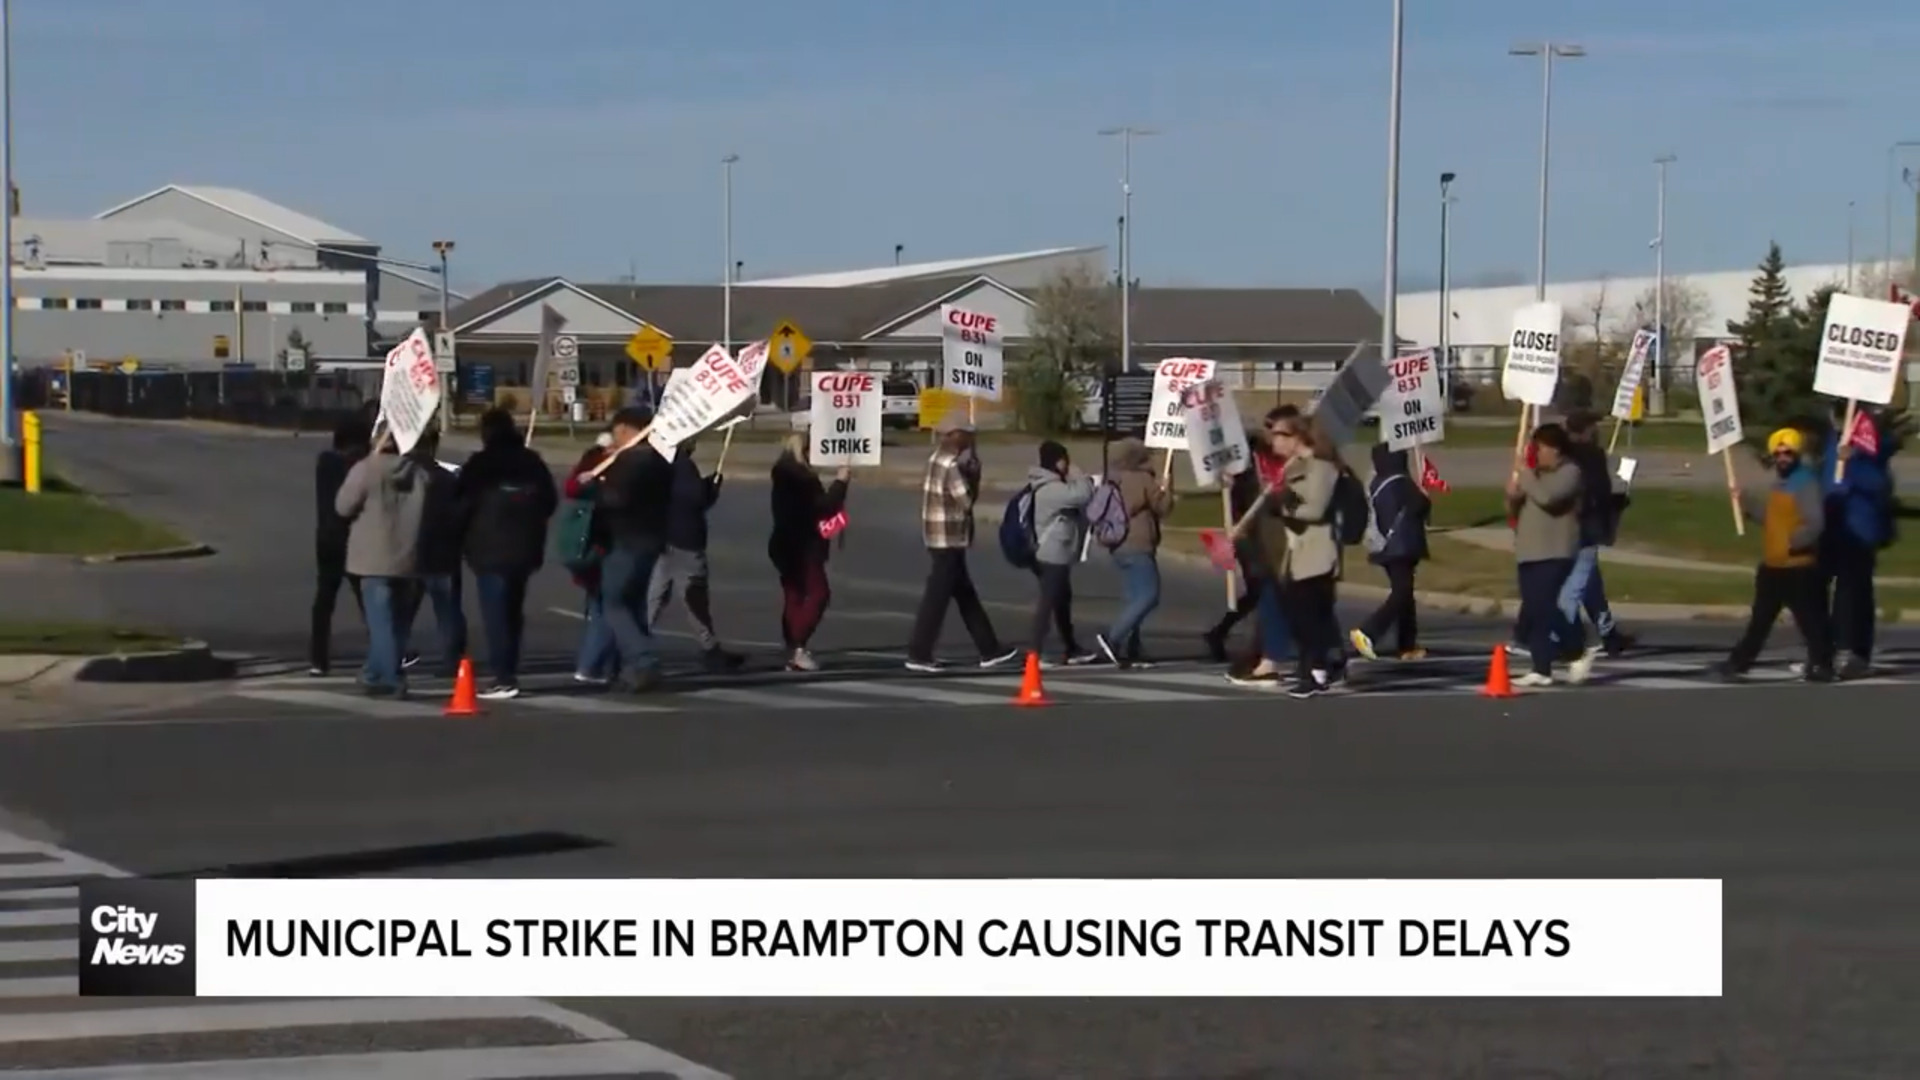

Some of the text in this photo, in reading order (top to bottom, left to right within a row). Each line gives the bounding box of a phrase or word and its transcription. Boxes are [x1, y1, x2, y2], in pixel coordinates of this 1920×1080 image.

[949, 310, 997, 333] CUPE
[961, 329, 986, 344] 831
[1828, 323, 1899, 352] CLOSED
[964, 351, 983, 367] ON
[1388, 356, 1430, 378] UPE
[560, 368, 577, 382] 40
[704, 350, 749, 394] CUPE
[1160, 362, 1208, 379] CUPE
[694, 369, 723, 397] 831
[818, 375, 875, 392] CUPE
[951, 368, 996, 391] STRIKE
[1398, 377, 1422, 394] 831
[832, 394, 861, 409] 831
[1403, 400, 1421, 416] ON
[836, 417, 856, 433] ON
[1151, 421, 1188, 438] STRIK
[1394, 416, 1437, 440] STRIKE
[820, 438, 872, 455] STRIKE
